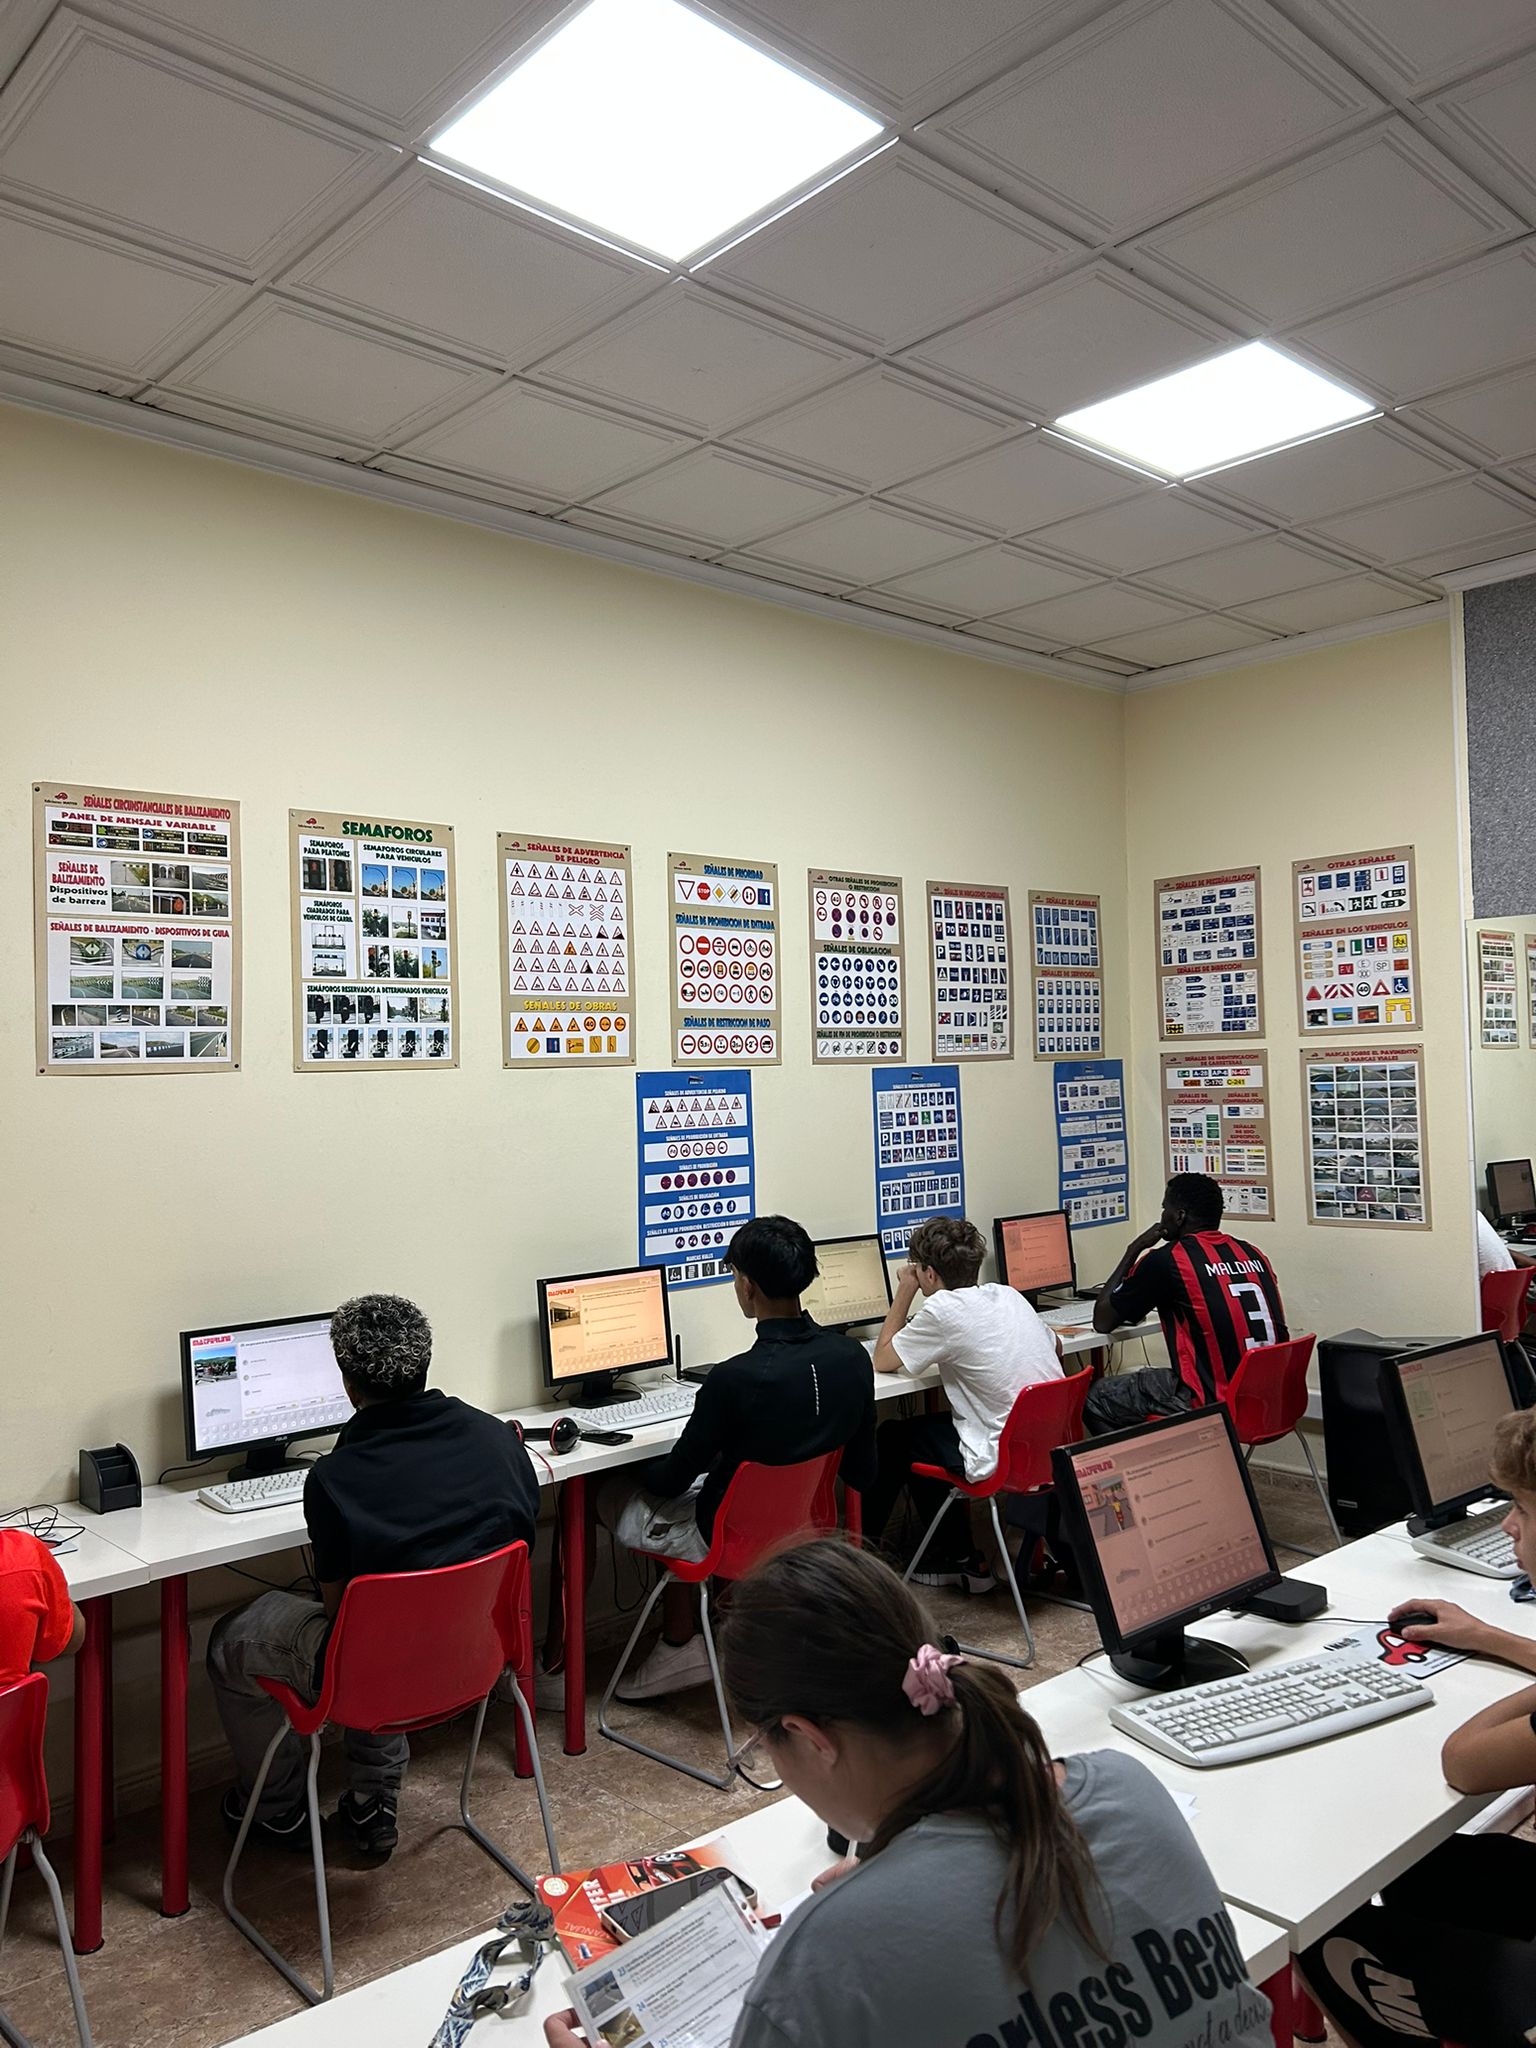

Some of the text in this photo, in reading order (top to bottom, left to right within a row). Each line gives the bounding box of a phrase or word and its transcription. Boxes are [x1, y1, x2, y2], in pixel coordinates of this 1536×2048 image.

[83, 794, 230, 819] SEÑALES CIRCUNSTANCIALES DE BALIZAMIENTO
[62, 812, 97, 821] PANEL
[116, 816, 162, 826] MENSAJE
[166, 821, 216, 831] VARIABLE
[342, 821, 432, 842] SEMAFOROS
[309, 840, 344, 849] SEMAFOROS
[363, 844, 442, 857] SEMAFOROS CIRCULARES
[527, 842, 560, 853] SEÑALES
[574, 848, 624, 860] ADVERTENCIA
[304, 847, 350, 857] PARA PEATONES
[397, 855, 431, 863] VEHICULOS
[567, 855, 600, 865] PELIGRO
[1328, 854, 1396, 869] OTRAS SEÑALES
[58, 861, 98, 874] SEÑALES DE
[704, 863, 763, 880] SEÑALES DE PRIORIDAD
[52, 873, 105, 886] BALIZAMIENTO
[50, 886, 108, 896] Dispositivos
[52, 895, 106, 905] de barrera
[676, 912, 698, 925] SEÑALES
[699, 915, 706, 925] DE
[743, 919, 750, 928] DE
[751, 920, 775, 930] ENTRADA
[50, 921, 82, 932] SEÑALES
[84, 924, 93, 932] DE
[95, 924, 149, 934] BALIZAMIENTO
[155, 927, 201, 937] DISPOSITIVOS
[202, 929, 211, 937] DE
[1302, 928, 1333, 938] SEÑALES
[1365, 921, 1408, 931] VEHICULOS
[824, 943, 847, 953] SEÑALES
[1352, 941, 1361, 955] L
[1367, 940, 1373, 948] L
[1379, 938, 1385, 946] L
[938, 946, 944, 957] P
[524, 999, 617, 1012] SEÑALES DE OBRAS
[684, 1015, 707, 1027] SEÑALES
[708, 1018, 715, 1027] DE
[749, 1018, 755, 1027] DE
[757, 1018, 770, 1028] PASO
[1204, 1260, 1264, 1277] MALDINI
[1228, 1283, 1276, 1350] 3
[618, 1966, 626, 1977] 23
[636, 2001, 646, 2011] 24
[658, 2038, 668, 2048] 25
